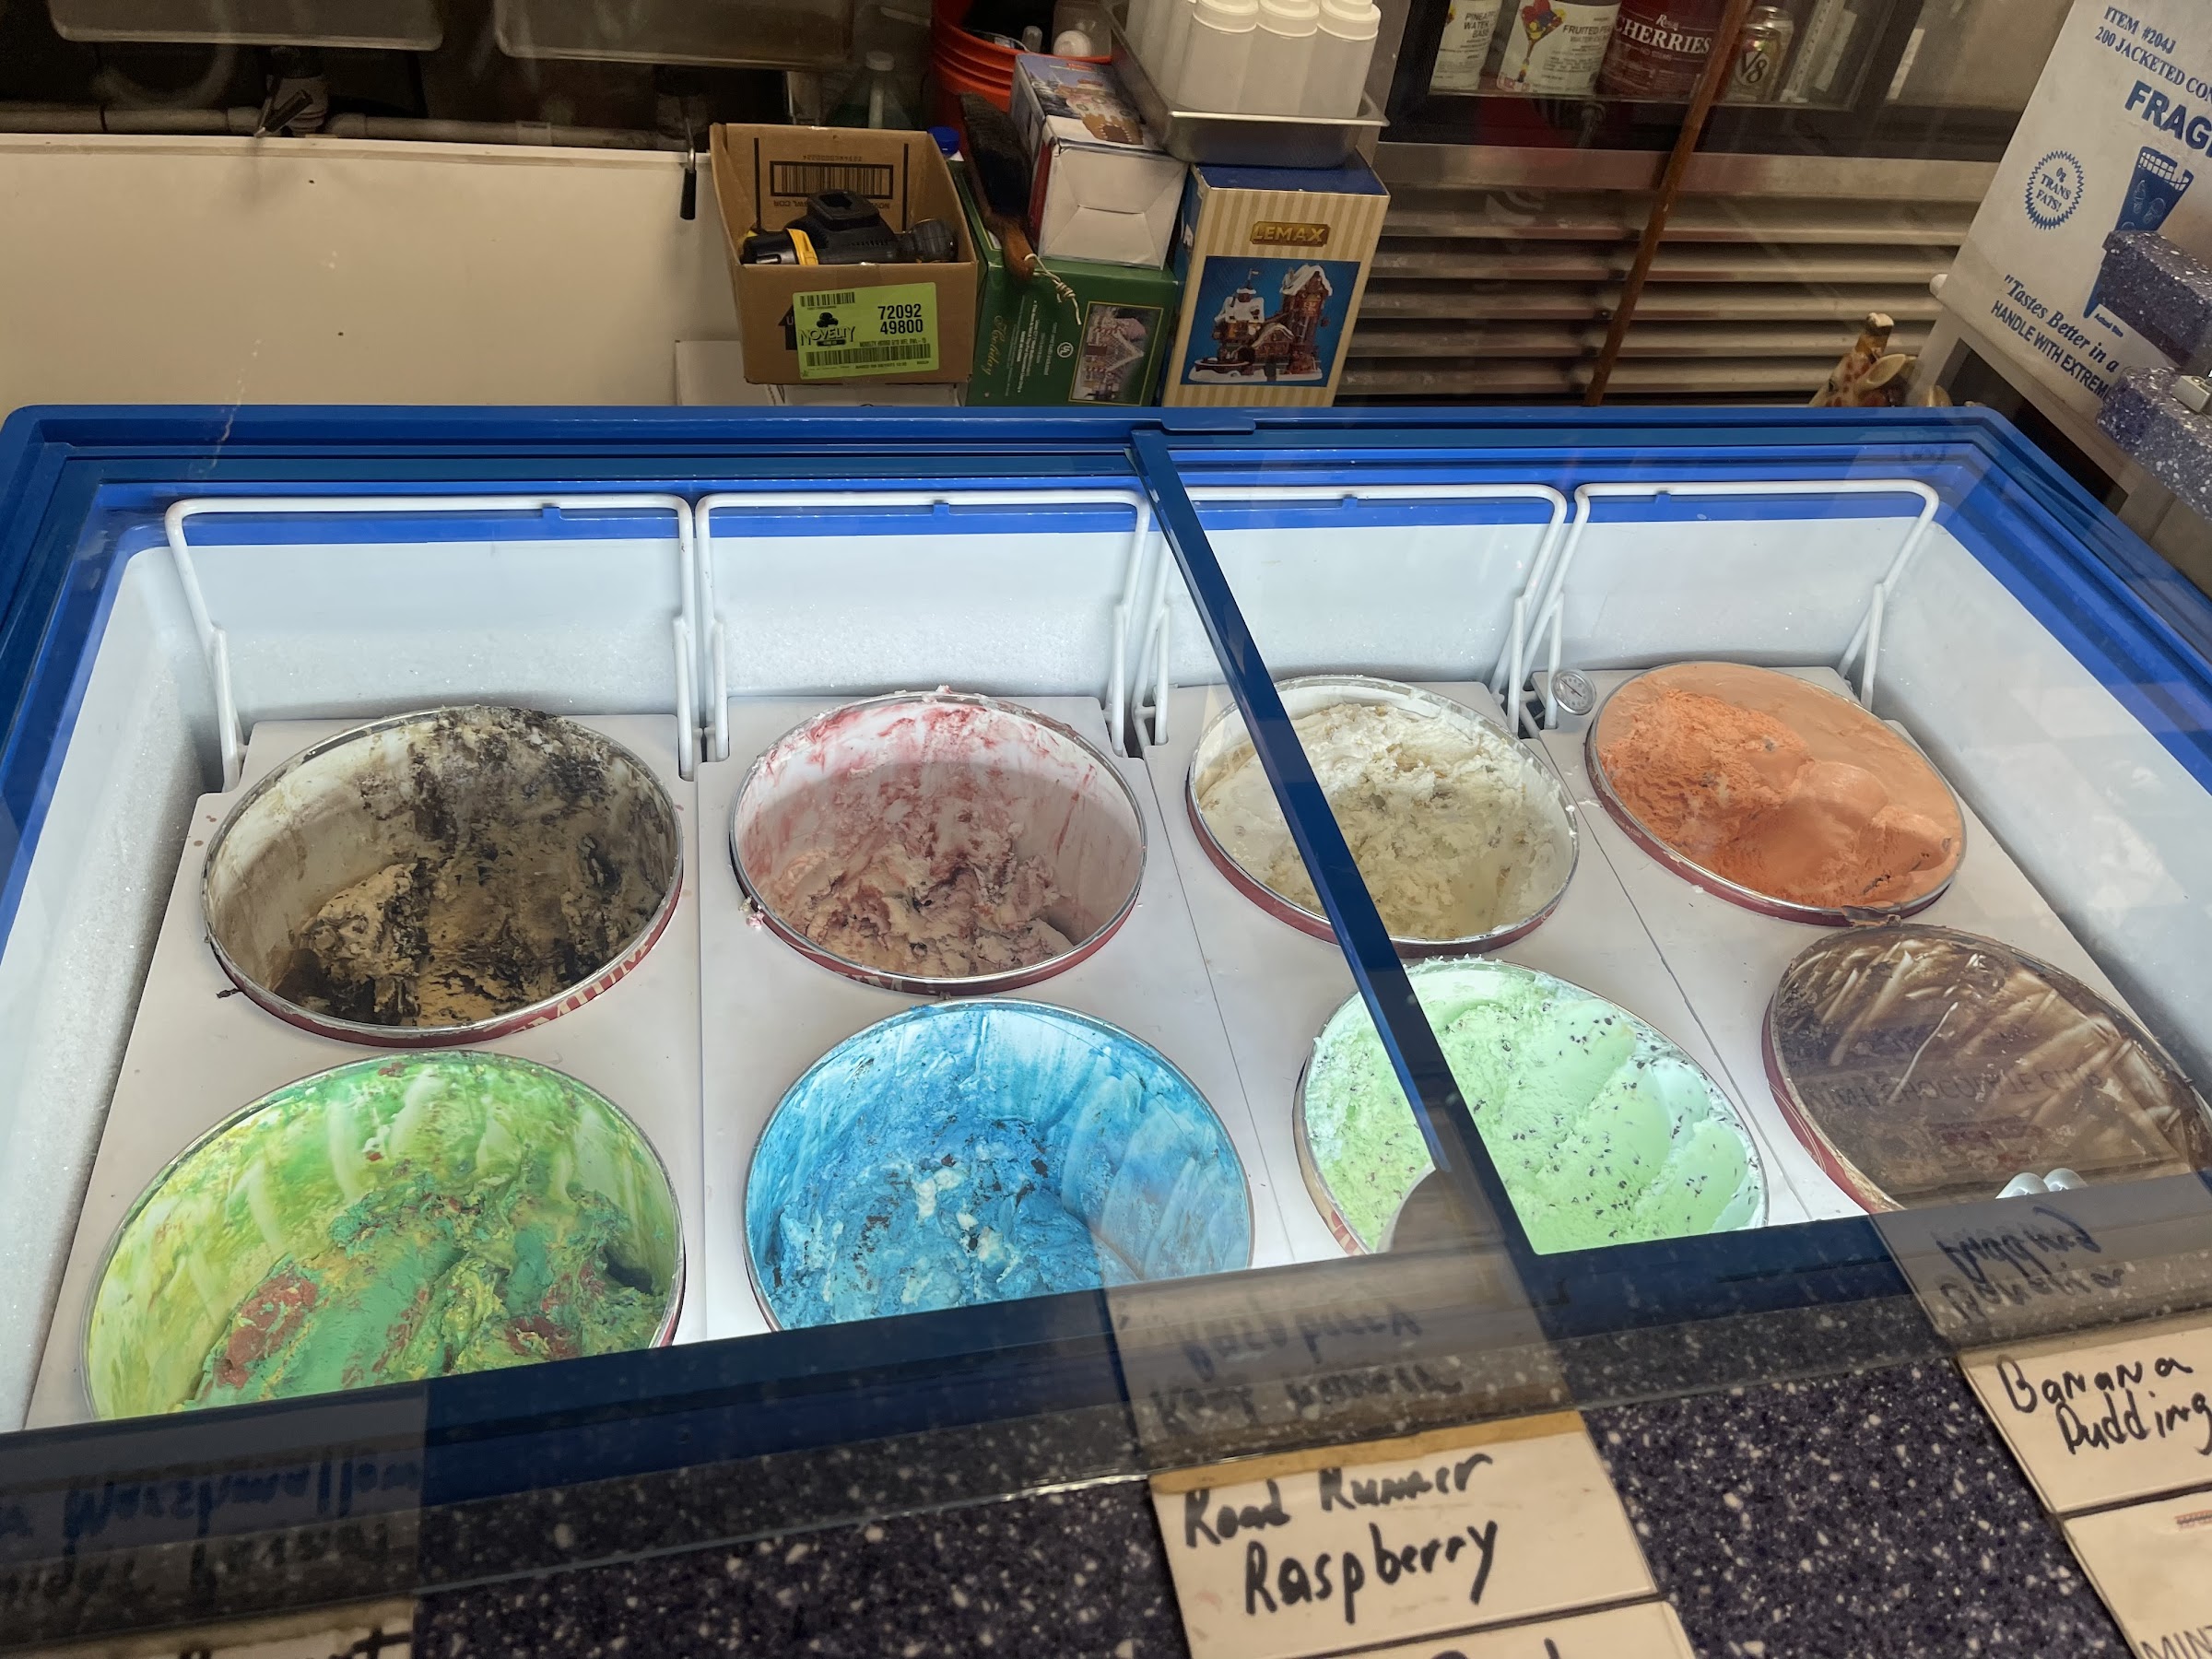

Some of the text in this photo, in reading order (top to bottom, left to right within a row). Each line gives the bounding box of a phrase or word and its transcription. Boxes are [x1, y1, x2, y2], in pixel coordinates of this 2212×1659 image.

[1562, 24, 1599, 35] FRUITED
[2103, 5, 2176, 54] ITEM #204J
[1741, 48, 1768, 84] V8
[2095, 26, 2116, 47] 200
[2115, 37, 2185, 86] JACKETED
[2036, 189, 2062, 212] FATS!
[2041, 173, 2071, 200] TRANS
[1252, 225, 1325, 242] LEMAX
[799, 325, 856, 347] NOVELTY
[877, 303, 922, 320] 72092
[880, 319, 924, 335] 49800
[2004, 274, 2119, 372] "Tastes Better in a
[981, 315, 1008, 376] Holiday
[1991, 300, 2111, 401] HANDLE WITH EXTREM
[1995, 1354, 2194, 1413] Banana
[2055, 1387, 2212, 1455] Pudding
[1183, 1479, 1290, 1547] Road
[1244, 1521, 1498, 1626] Raspberry
